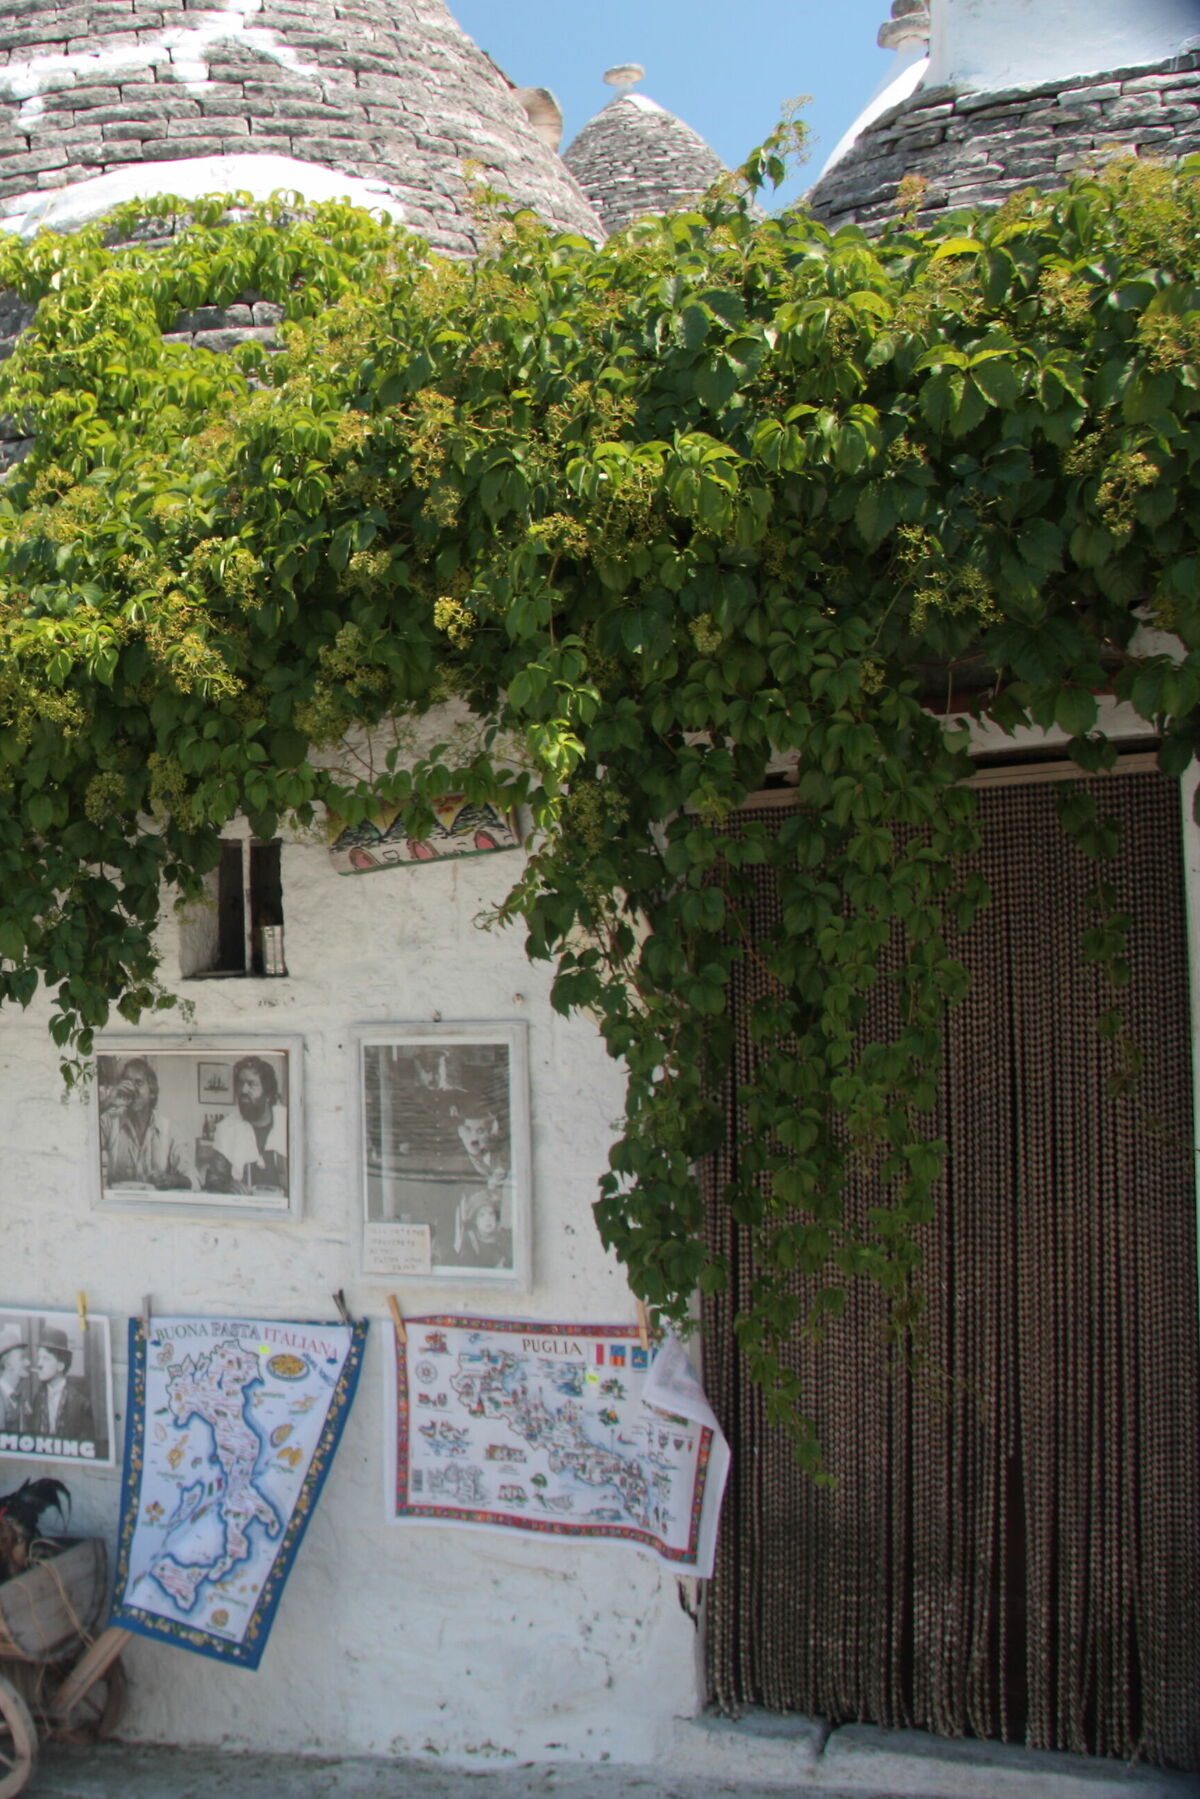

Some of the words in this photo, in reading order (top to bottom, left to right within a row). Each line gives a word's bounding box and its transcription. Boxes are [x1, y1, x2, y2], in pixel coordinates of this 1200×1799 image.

[155, 1324, 209, 1341] BUONA
[210, 1322, 261, 1341] PASTA
[522, 1338, 583, 1355] PUGLIA
